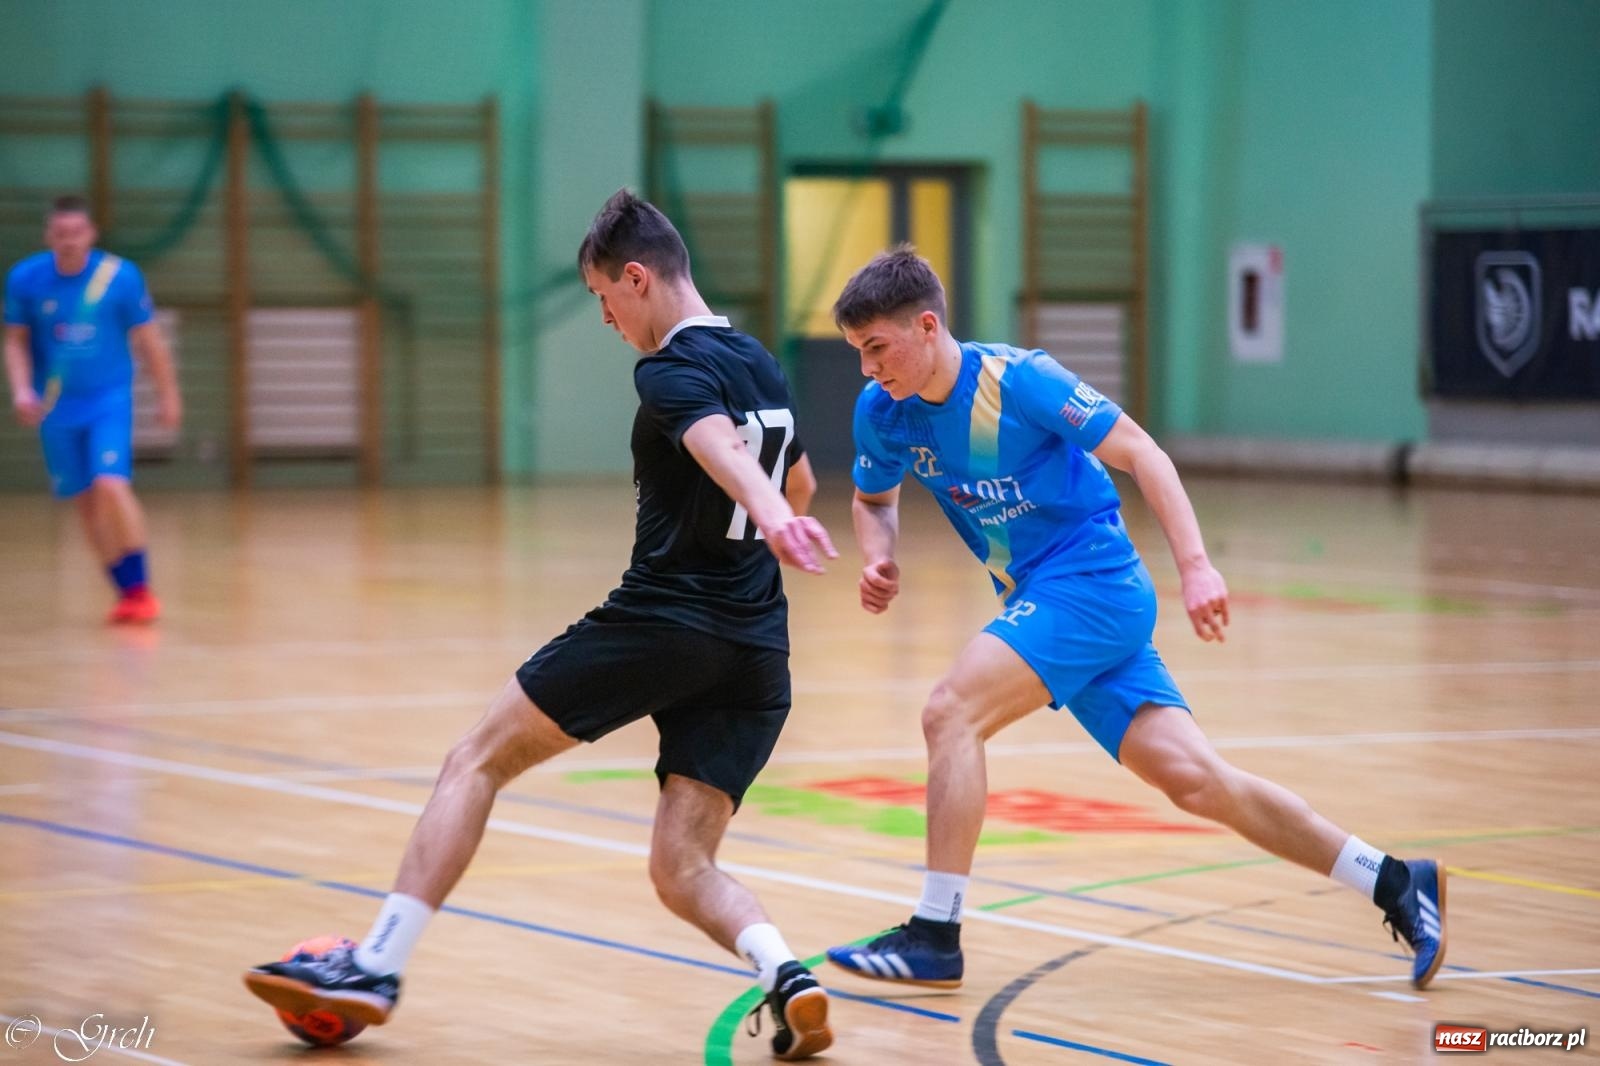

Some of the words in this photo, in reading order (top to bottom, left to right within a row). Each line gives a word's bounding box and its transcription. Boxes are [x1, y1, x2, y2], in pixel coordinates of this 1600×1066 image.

[725, 408, 795, 540] 17
[909, 446, 943, 478] 22
[996, 599, 1037, 627] 22
